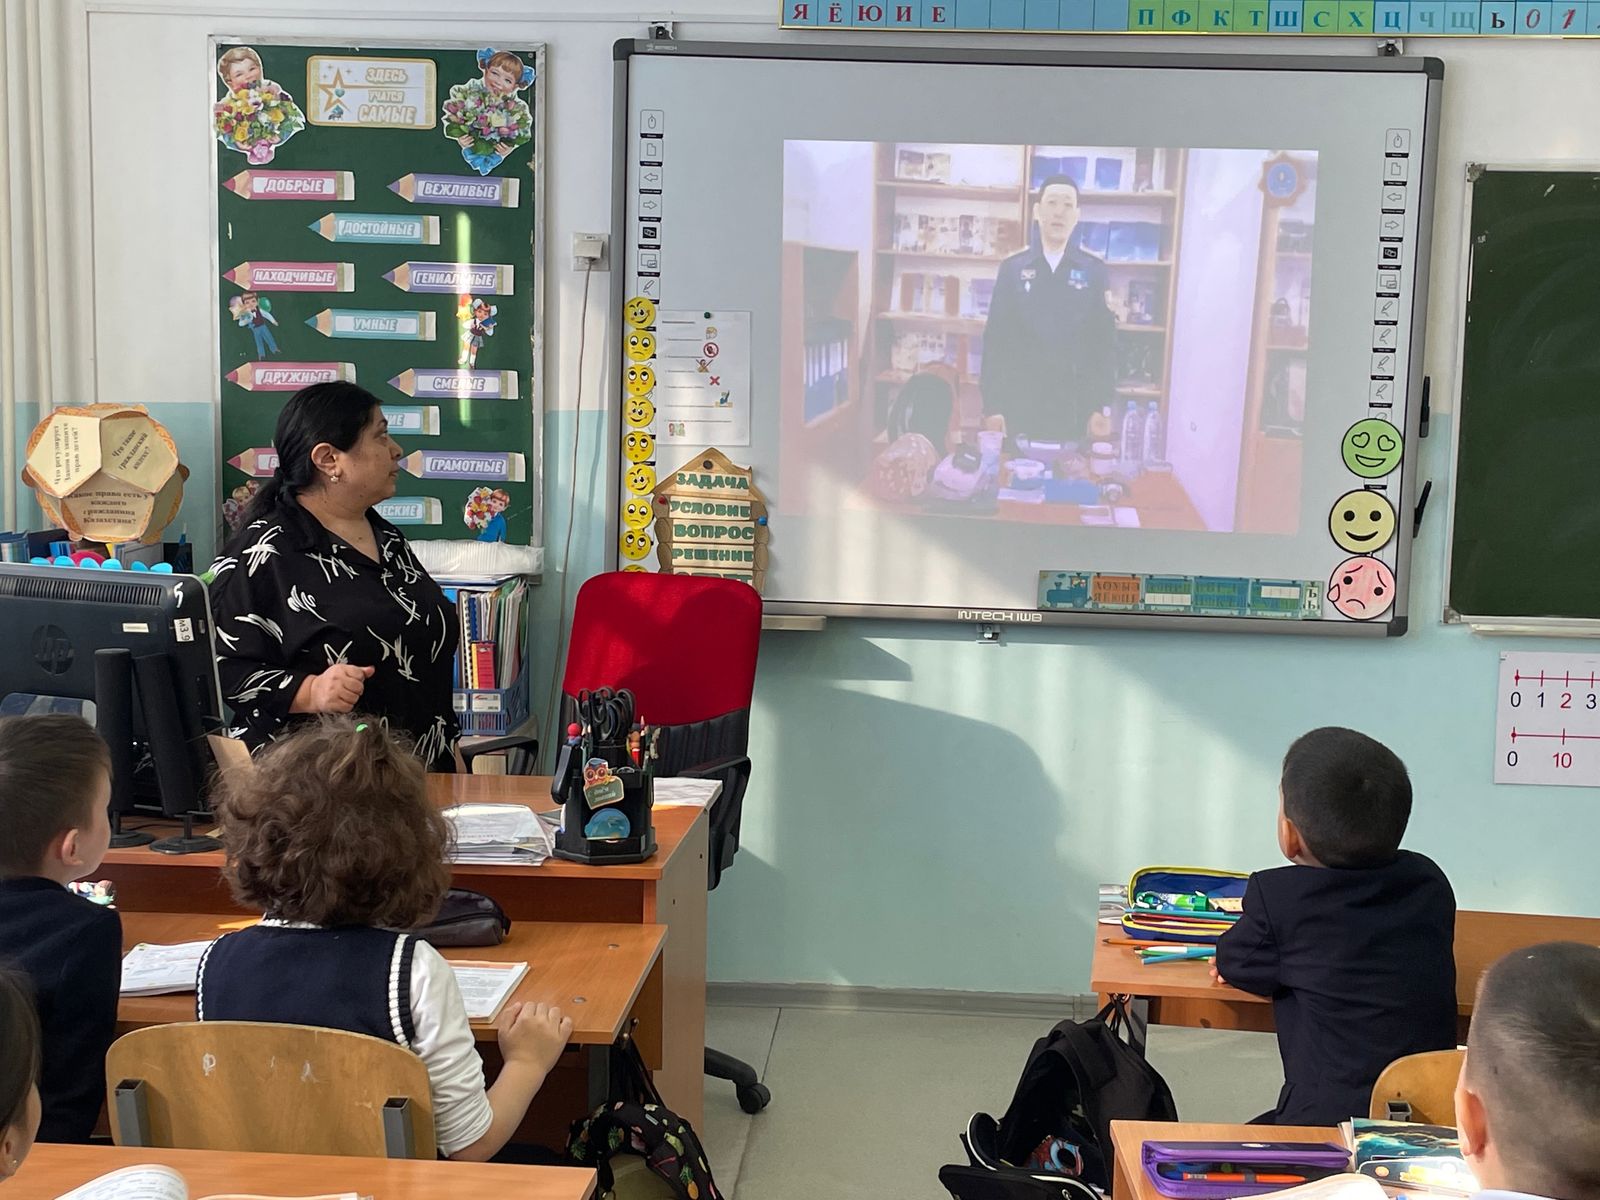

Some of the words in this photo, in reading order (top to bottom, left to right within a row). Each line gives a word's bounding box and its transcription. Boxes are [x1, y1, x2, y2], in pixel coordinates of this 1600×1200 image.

[792, 4, 808, 20] Я
[829, 3, 843, 23] Ё
[858, 5, 883, 22] Ю
[932, 6, 946, 23] Е
[1138, 9, 1154, 26] П
[1171, 9, 1191, 26] Ф
[1213, 9, 1230, 26] К
[1249, 10, 1264, 27] Т
[1274, 10, 1298, 27] Ш
[1313, 11, 1330, 28] С
[1348, 11, 1365, 28] Х
[1384, 11, 1400, 30] Ц
[1419, 11, 1435, 28] Ч
[1451, 12, 1475, 31] Щ
[1491, 12, 1505, 29] Ь
[366, 68, 407, 83] ЗДЕСЬ
[368, 89, 404, 103] УЧАТСЯ
[358, 104, 417, 125] САМЫЕ
[265, 178, 324, 193] ДОБРЫЕ
[423, 181, 497, 199] ВЕЖЛИВЫЕ
[341, 219, 415, 236] ДОСТОЙНЫЕ
[254, 270, 335, 284] НАХОДЧИВЫЕ
[354, 318, 398, 332] УМНЫЕ
[262, 370, 331, 385] ДРУЖНЫЕ
[431, 458, 504, 473] ГРАМОТНЫЕ
[676, 472, 750, 489] ЗАДАЧА
[669, 500, 751, 518] УСЛОВИЕ
[673, 523, 755, 540] ВОПРОС
[671, 547, 754, 562] РЕШЕНИЕ
[1016, 612, 1043, 622] IWB
[1510, 691, 1522, 708] 0
[1537, 691, 1545, 708] 1
[1560, 692, 1572, 709] 2
[1586, 693, 1597, 710] 3
[1507, 750, 1518, 767] 0
[1552, 752, 1573, 769] 10
